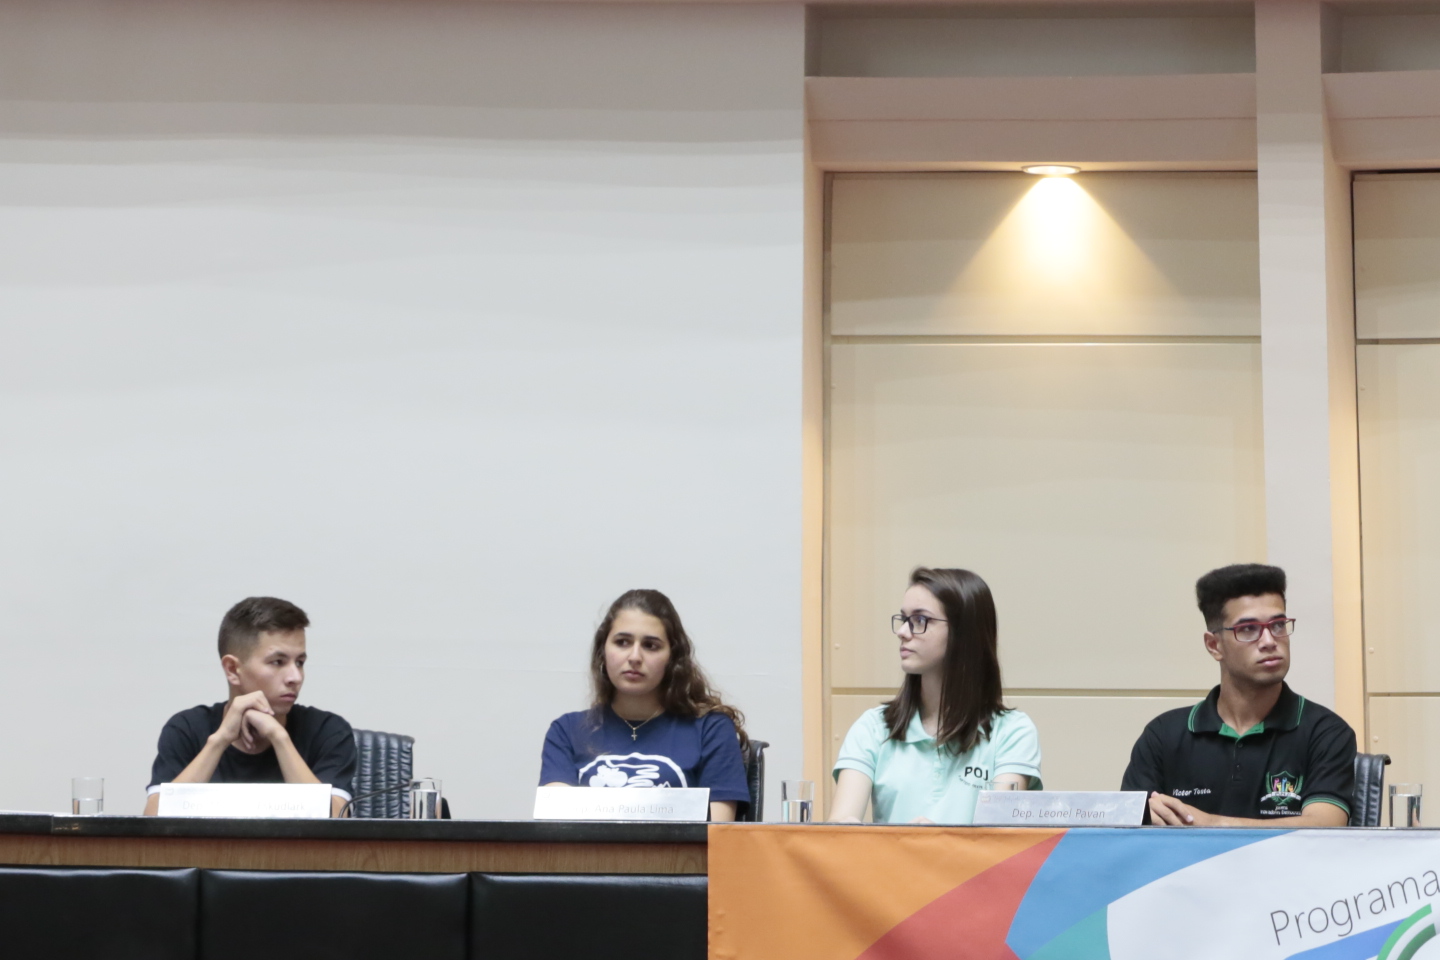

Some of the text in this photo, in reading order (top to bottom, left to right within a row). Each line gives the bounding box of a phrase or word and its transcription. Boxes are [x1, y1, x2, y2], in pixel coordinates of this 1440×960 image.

[964, 766, 989, 781] POJ
[594, 804, 615, 813] Ana
[618, 804, 646, 814] Paula
[649, 804, 674, 814] Lima
[1011, 807, 1106, 820] Dep. Leonel Pavan
